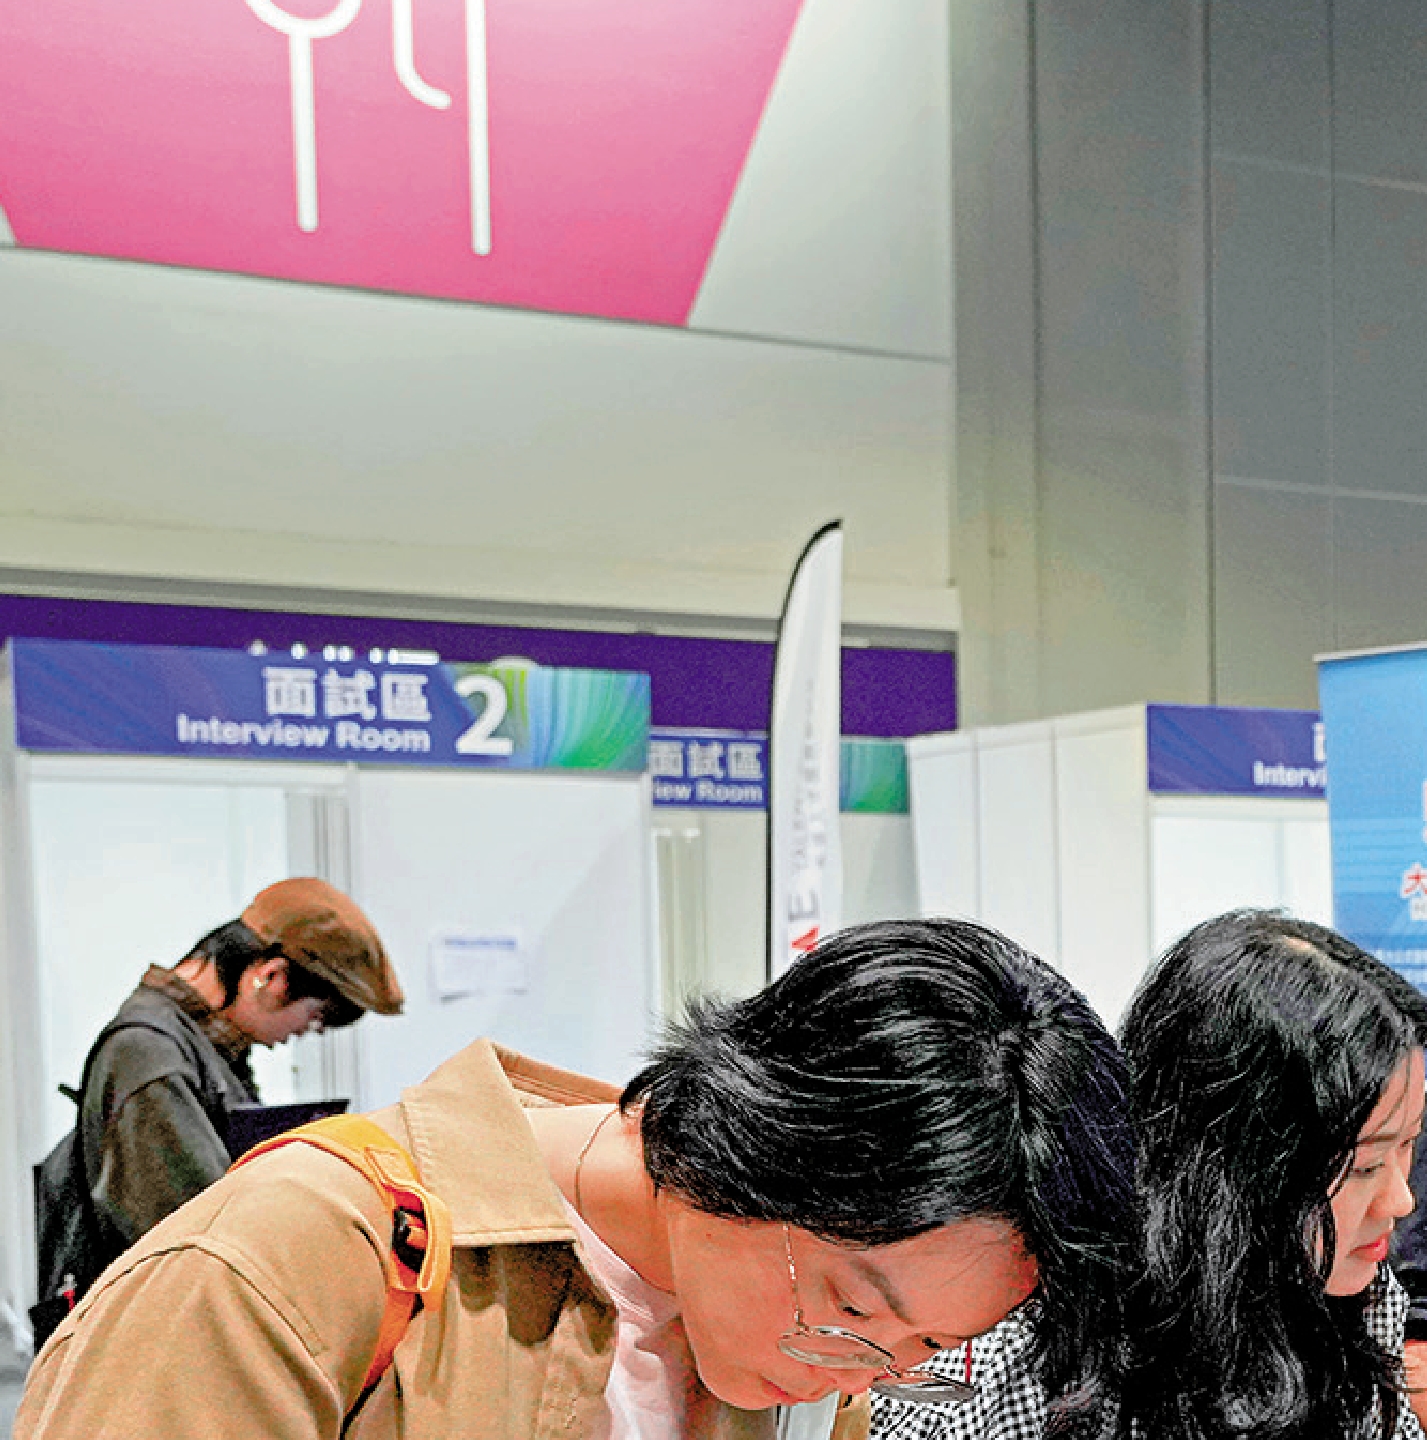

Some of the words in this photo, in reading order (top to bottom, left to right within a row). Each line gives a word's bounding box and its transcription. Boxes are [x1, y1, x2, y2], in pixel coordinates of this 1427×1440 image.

[262, 667, 431, 721] 面試區
[454, 675, 514, 755] 2
[177, 713, 330, 747] Interview
[335, 720, 431, 752] Room
[696, 779, 763, 803] Room
